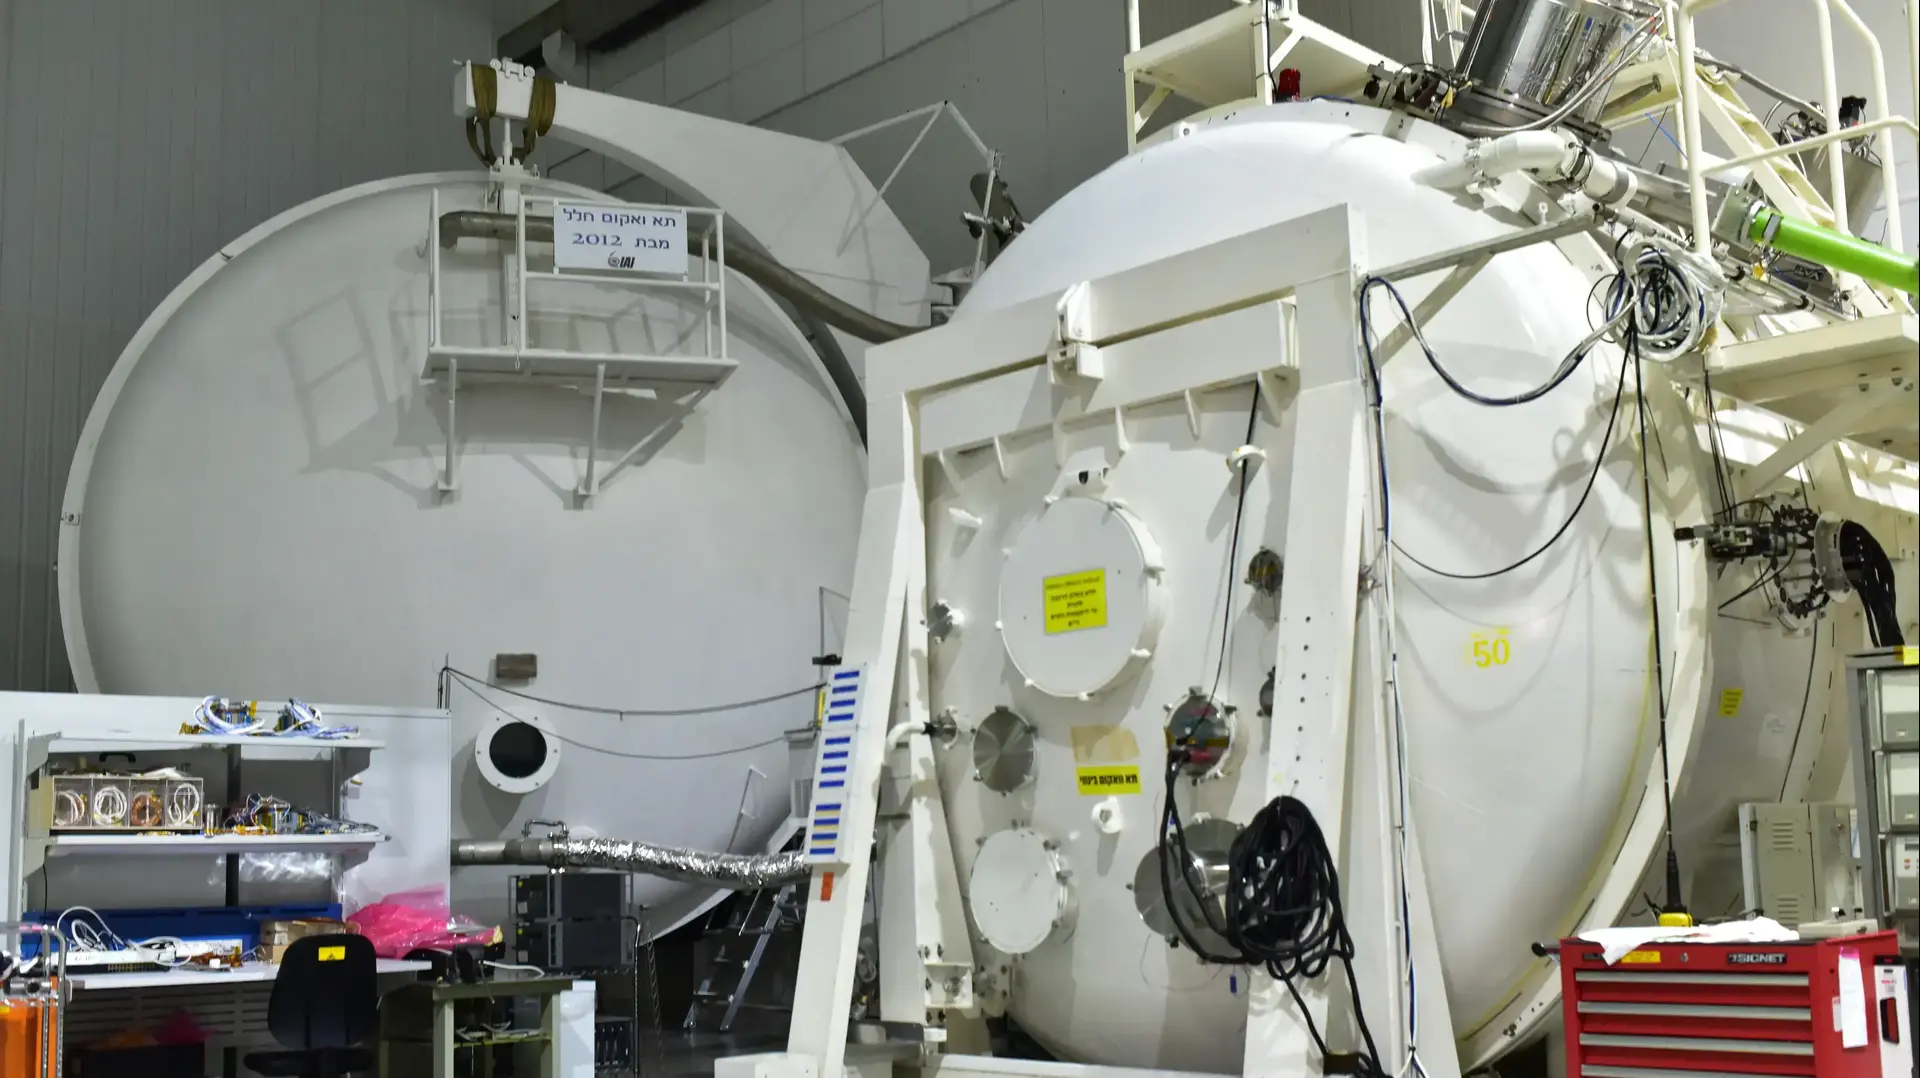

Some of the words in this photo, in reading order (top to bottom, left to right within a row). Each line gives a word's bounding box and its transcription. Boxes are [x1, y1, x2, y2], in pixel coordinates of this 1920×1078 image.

[563, 207, 595, 222] חלל
[602, 212, 646, 227] ואקום
[653, 214, 676, 228] תא
[572, 233, 622, 247] 2012
[634, 237, 670, 250] מבת
[1473, 638, 1511, 668] 50
[1737, 953, 1786, 964] SIGNET
